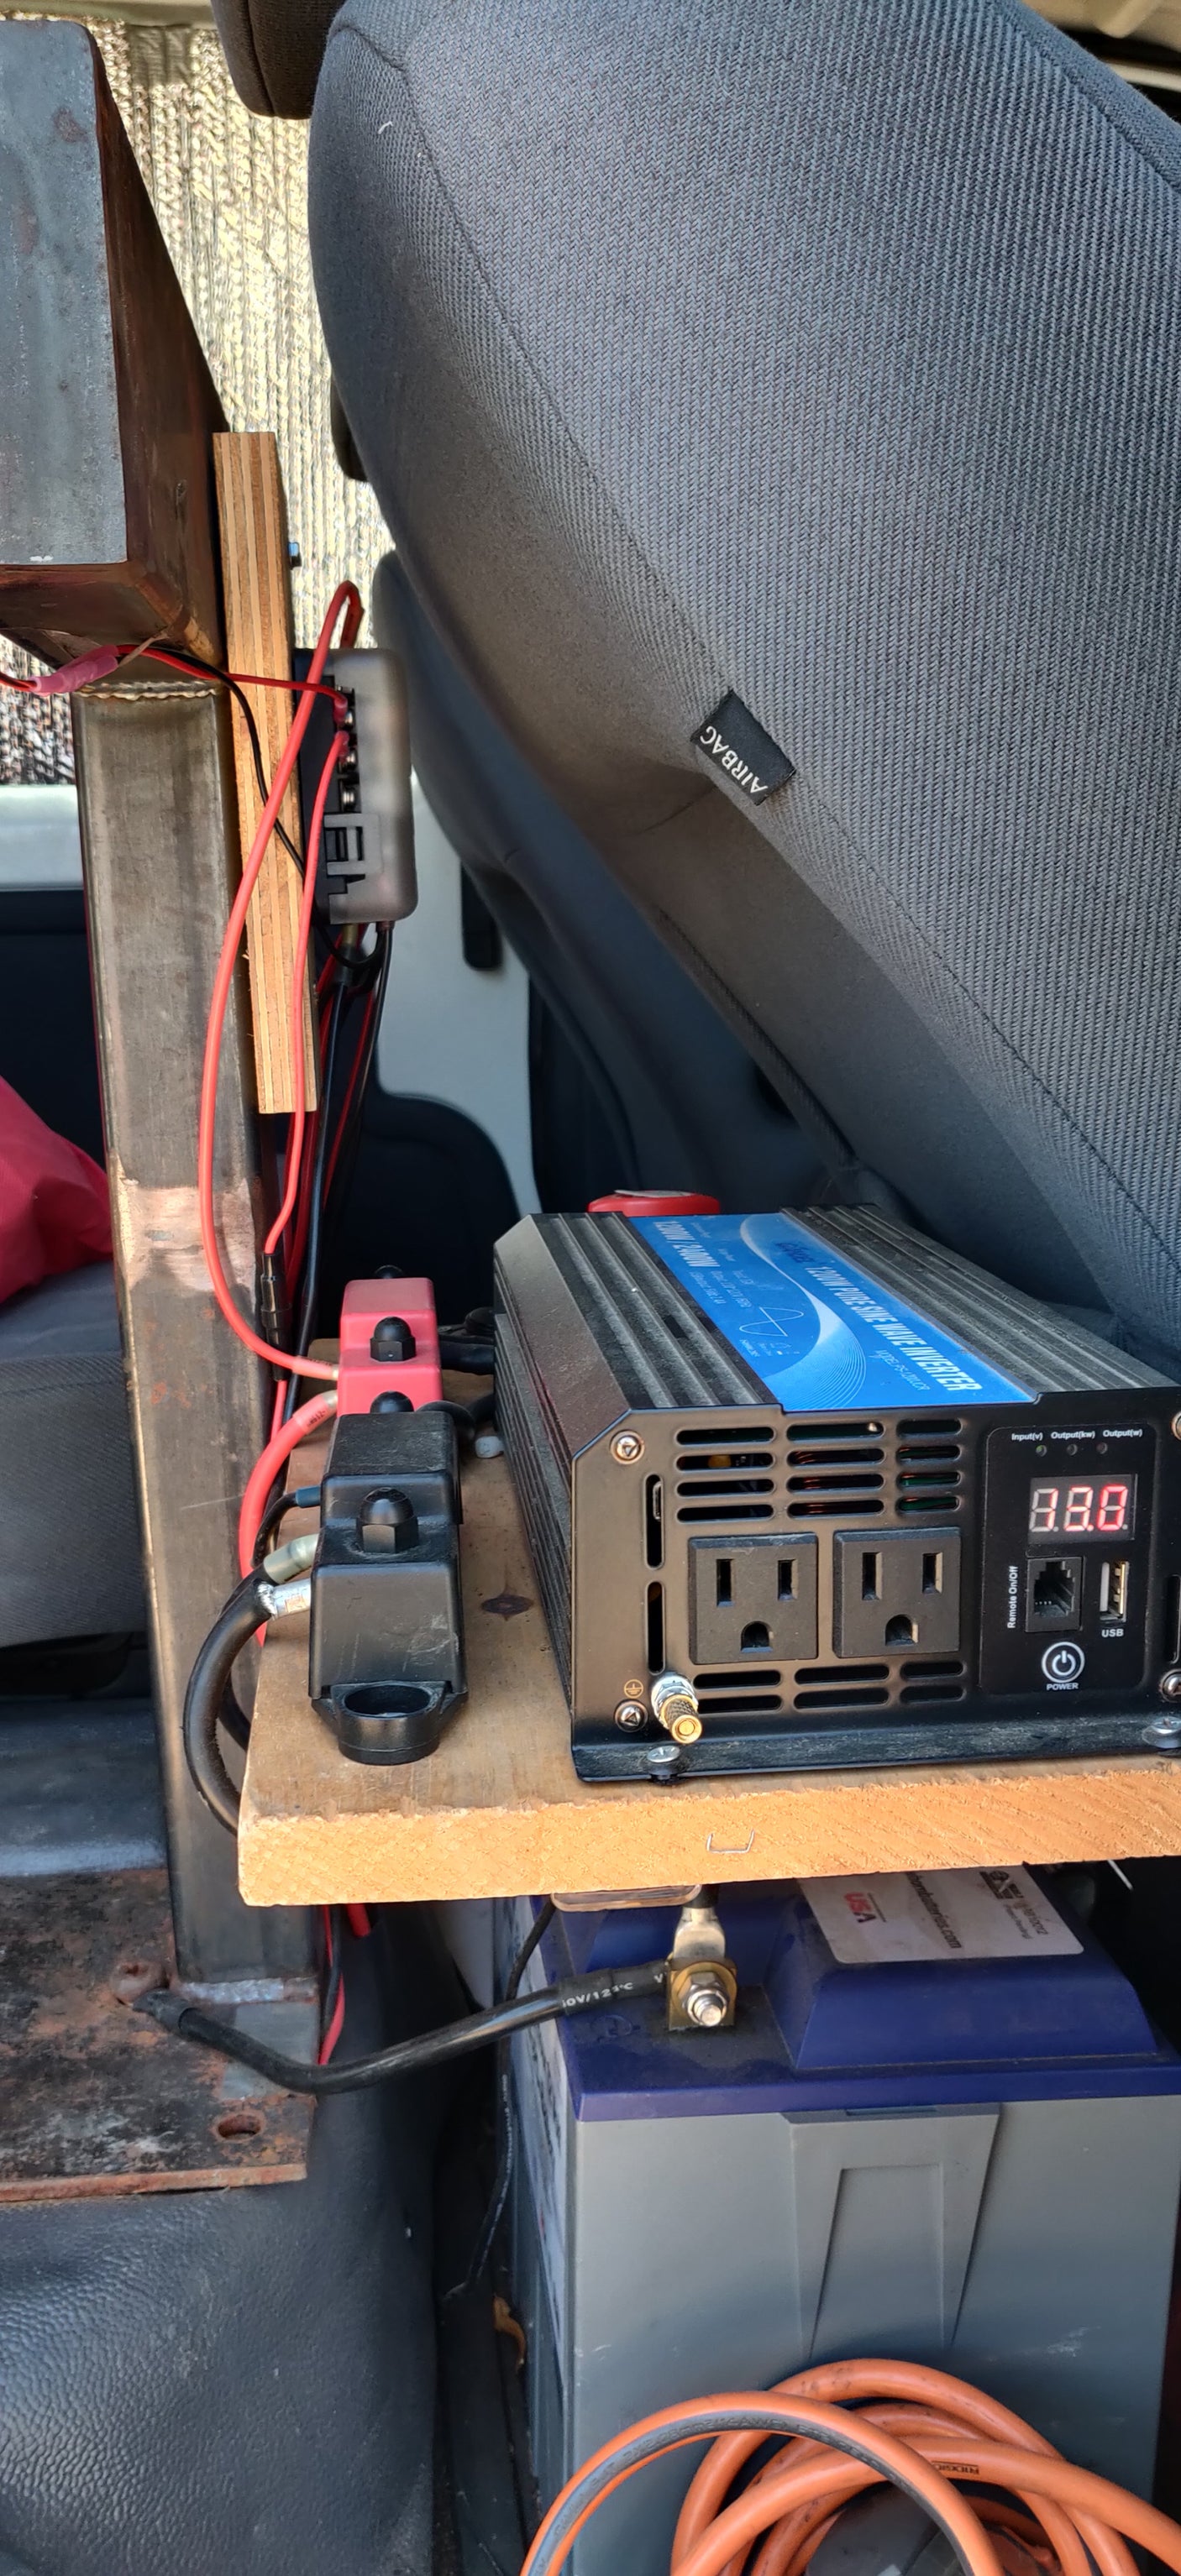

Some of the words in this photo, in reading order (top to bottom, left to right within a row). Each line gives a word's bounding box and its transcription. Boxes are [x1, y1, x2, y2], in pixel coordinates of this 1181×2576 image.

[700, 725, 768, 793] AIRBAG
[673, 1244, 721, 1267] 2400W
[805, 1265, 847, 1286] 1200W
[829, 1285, 872, 1305] PURE
[851, 1301, 898, 1322] SINE
[874, 1323, 928, 1346] WAVE
[900, 1345, 984, 1391] INVERTER
[1011, 1432, 1043, 1442] Input(v)
[1051, 1431, 1095, 1440] Output(kw)
[1103, 1429, 1143, 1437] Output(w)
[1009, 1565, 1018, 1593] On/Off
[1007, 1594, 1017, 1629] Remote
[1101, 1628, 1124, 1637] USB
[1047, 1682, 1079, 1691] POWER
[843, 1892, 877, 1924] USA
